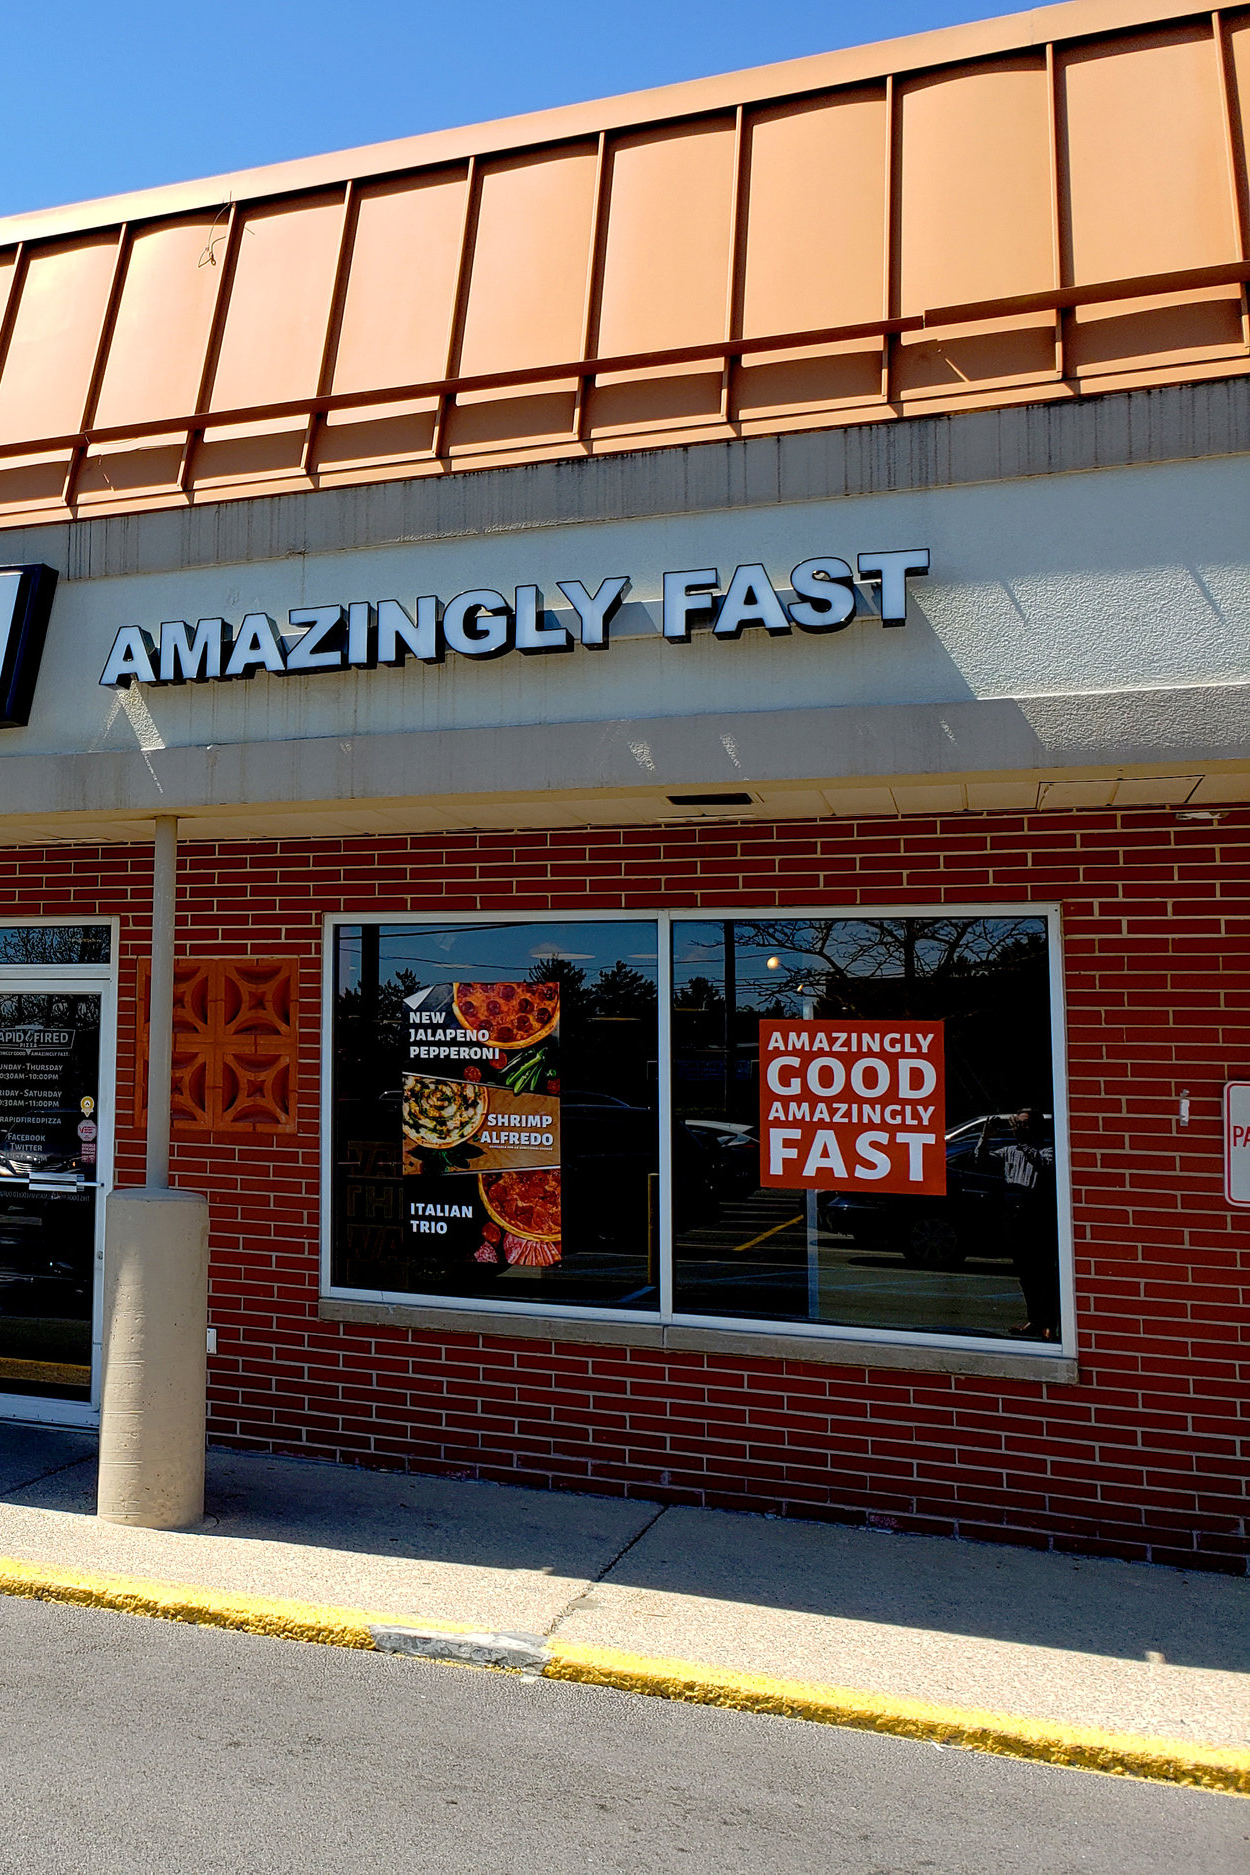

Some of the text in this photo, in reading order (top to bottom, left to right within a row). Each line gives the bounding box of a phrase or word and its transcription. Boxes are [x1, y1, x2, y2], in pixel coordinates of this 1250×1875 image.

[98, 548, 932, 687] AMAZINGLY FAST
[410, 1012, 446, 1023] NEW
[34, 1032, 68, 1043] FIRED
[409, 1029, 489, 1042] JALAPENO
[768, 1032, 934, 1052] AMAZINGLY
[410, 1046, 499, 1059] PEPPERONI
[766, 1056, 936, 1099] GOOD
[487, 1114, 552, 1128] SHRIMP
[768, 1102, 935, 1125] AMAZINGLY
[480, 1131, 553, 1146] ALFREDO
[769, 1128, 936, 1181] FAST
[410, 1203, 473, 1218] ITALIAN
[410, 1220, 447, 1234] TRIO
